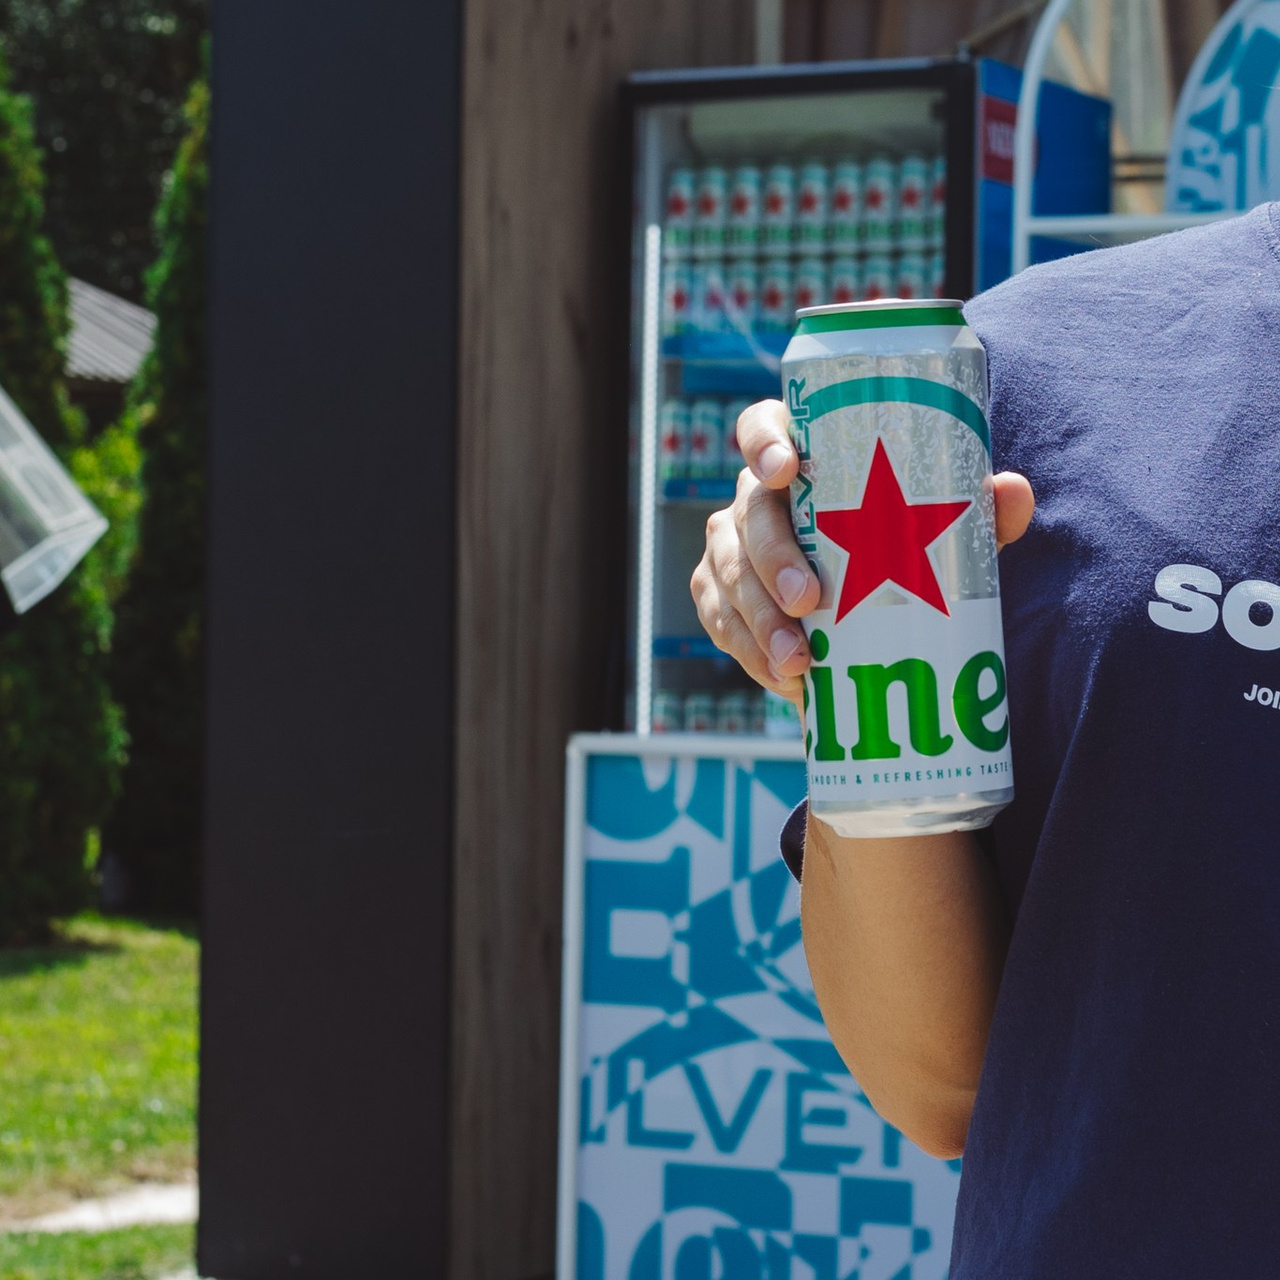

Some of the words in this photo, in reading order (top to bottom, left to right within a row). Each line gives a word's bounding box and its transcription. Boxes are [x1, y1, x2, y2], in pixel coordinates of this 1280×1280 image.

[806, 629, 1008, 761] ine
[811, 775, 846, 785] SMOOTH
[856, 774, 862, 785] &
[873, 766, 972, 784] REFRESHING
[980, 761, 1008, 776] TASTE
